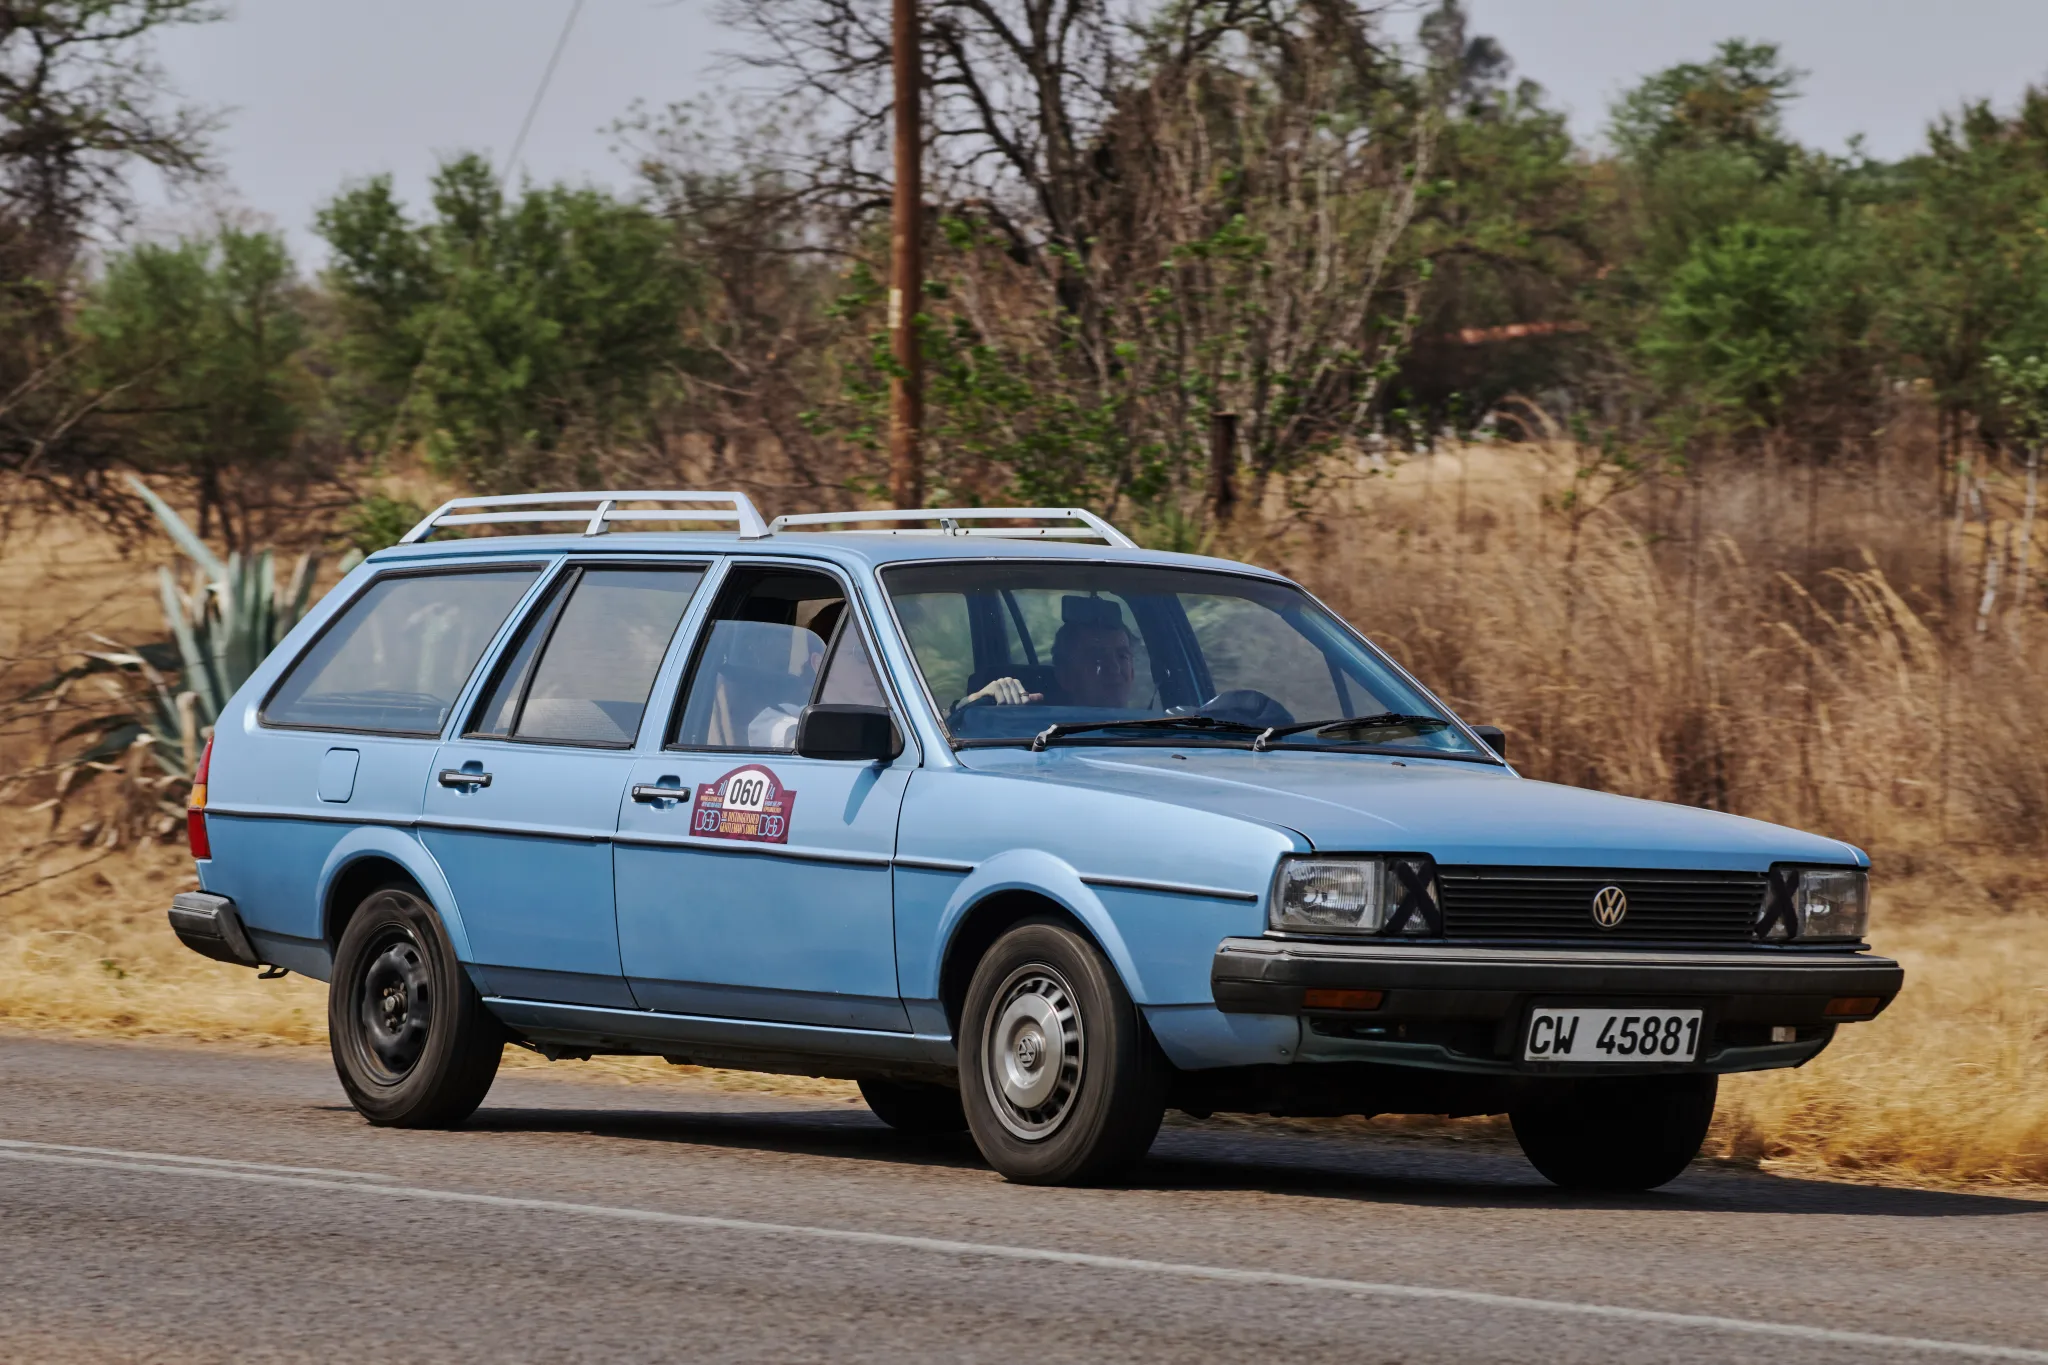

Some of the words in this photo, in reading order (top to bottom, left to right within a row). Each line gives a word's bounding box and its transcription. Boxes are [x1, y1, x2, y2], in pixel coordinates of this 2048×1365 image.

[730, 778, 764, 807] 060
[1593, 886, 1627, 927] VW
[1529, 1015, 1580, 1055] CW
[1596, 1015, 1700, 1056] 45881
